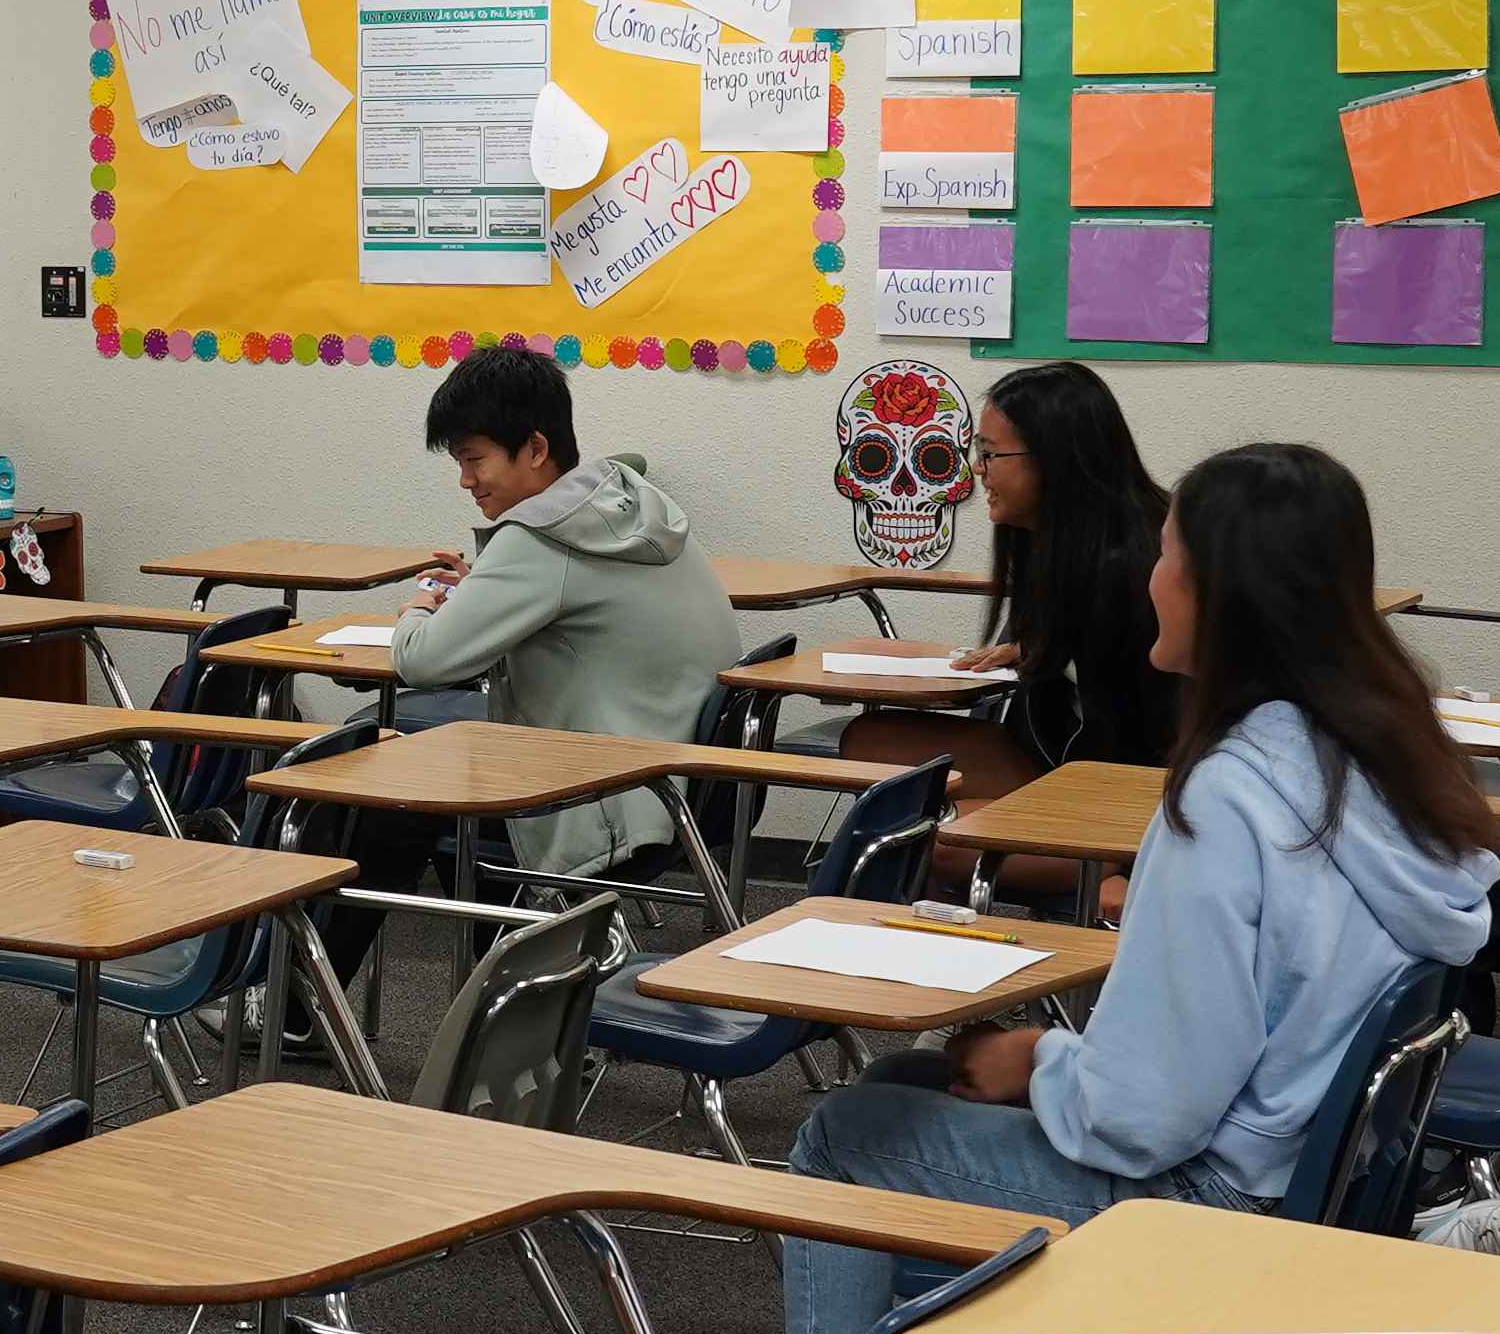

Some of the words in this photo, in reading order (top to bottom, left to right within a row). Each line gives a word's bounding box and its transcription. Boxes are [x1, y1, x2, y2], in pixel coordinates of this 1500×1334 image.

[170, 9, 211, 40] me
[194, 34, 227, 74] así
[896, 27, 1015, 61] Spanish
[706, 45, 774, 66] Necesito
[778, 46, 829, 77] ayuda
[249, 62, 289, 96] ¿Qué
[289, 95, 317, 119] tal?
[703, 70, 748, 102] tengo
[757, 71, 786, 85] una
[142, 115, 182, 144] Tengo
[189, 132, 235, 147] ¿Cómo
[243, 129, 280, 142] estuvo
[211, 149, 224, 165] tu
[232, 146, 264, 163] día?
[924, 169, 1008, 202] Spanish
[550, 230, 579, 259] Me
[576, 195, 627, 256] gusta
[574, 273, 607, 304] Me
[607, 218, 678, 285] encanta
[885, 272, 996, 296] Academic
[895, 302, 985, 327] Success
